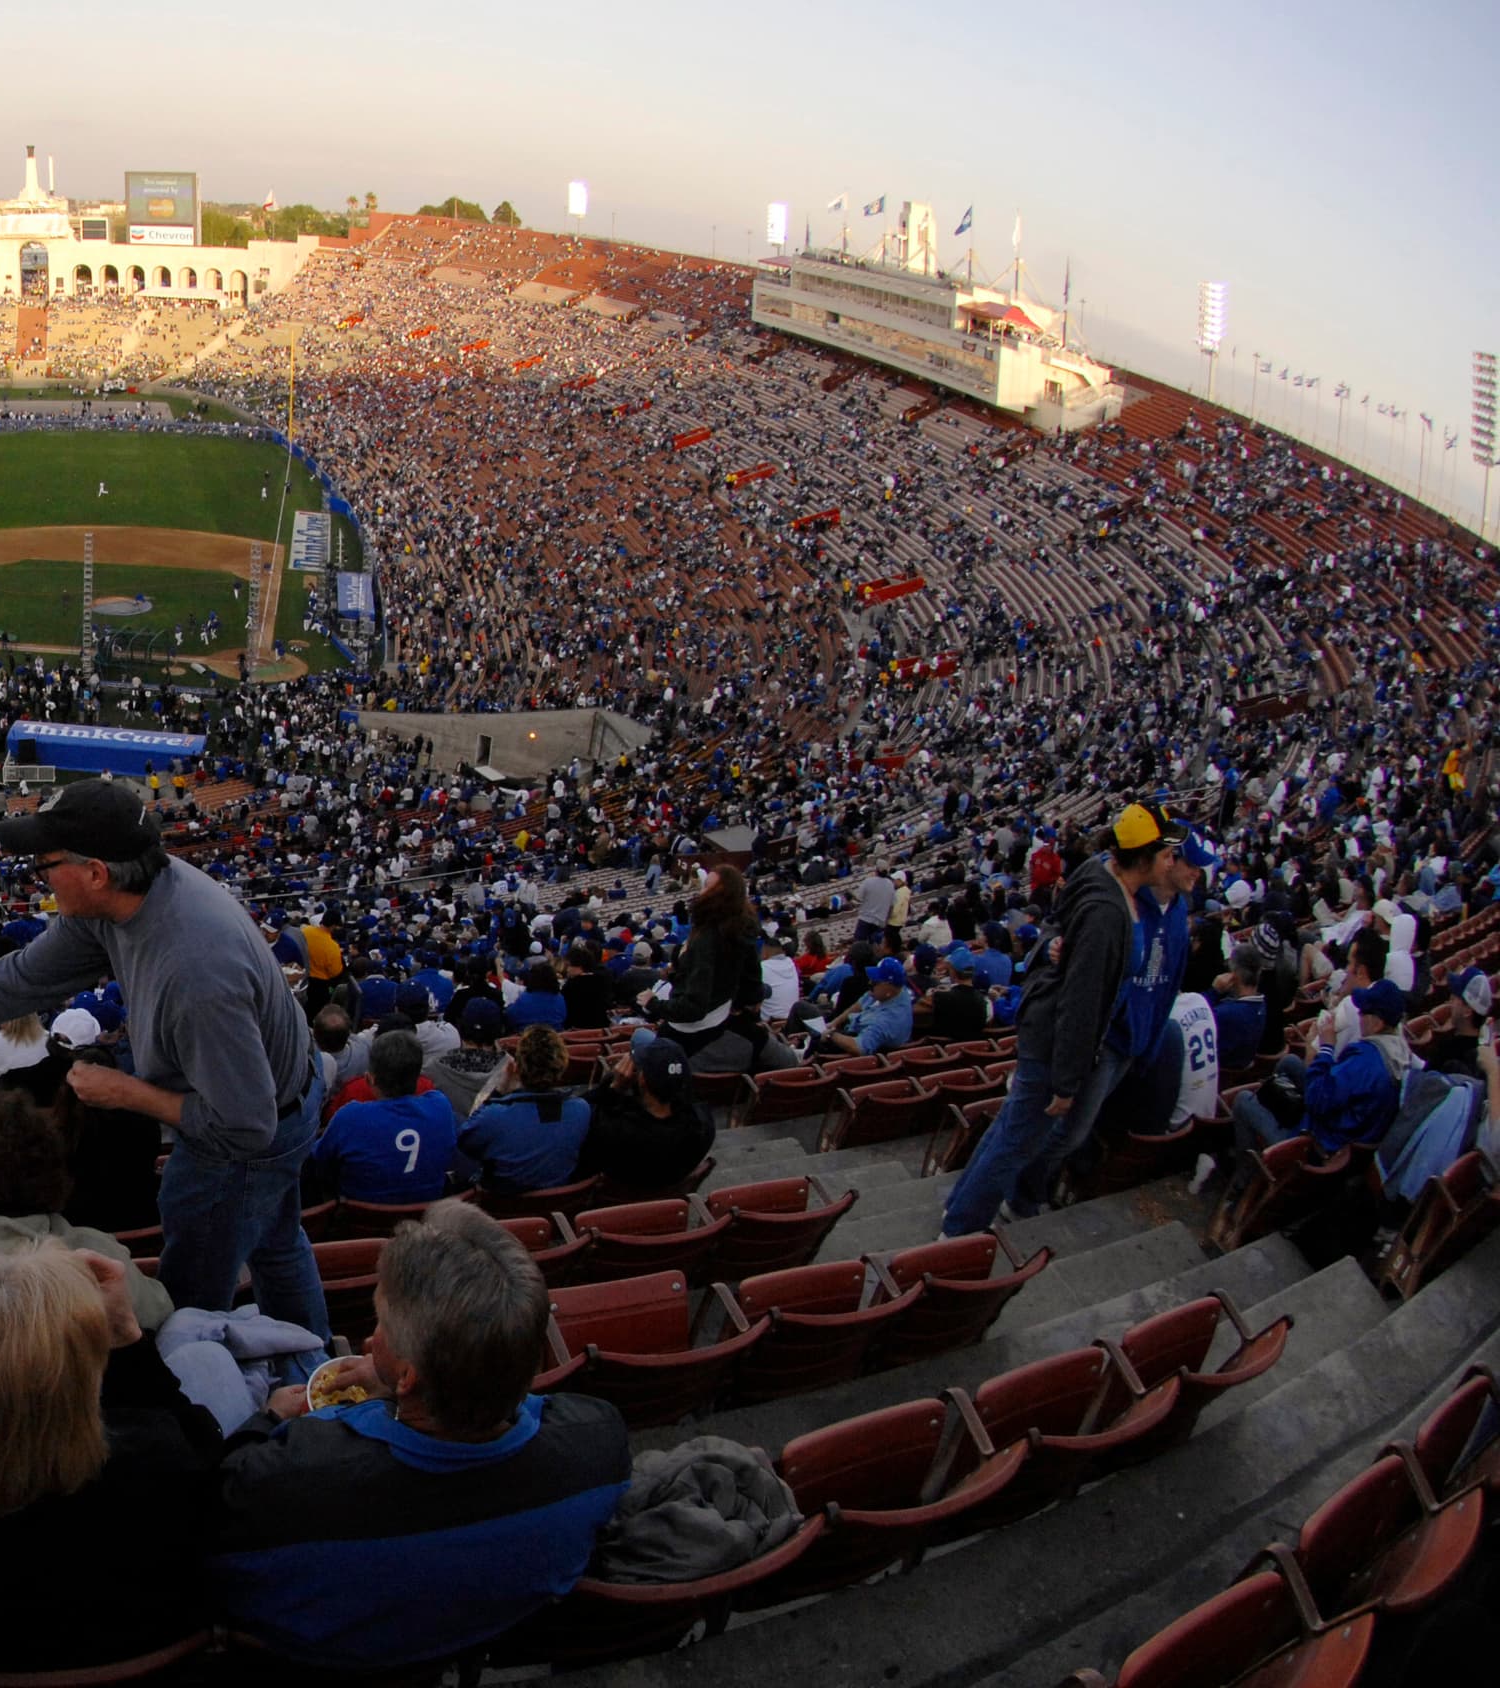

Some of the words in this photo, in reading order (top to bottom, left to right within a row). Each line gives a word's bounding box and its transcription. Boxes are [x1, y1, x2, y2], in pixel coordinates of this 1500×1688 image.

[148, 230, 193, 241] Chevron
[23, 722, 196, 747] ThinkCure!
[1188, 1028, 1215, 1072] 29
[395, 1128, 420, 1174] 9
